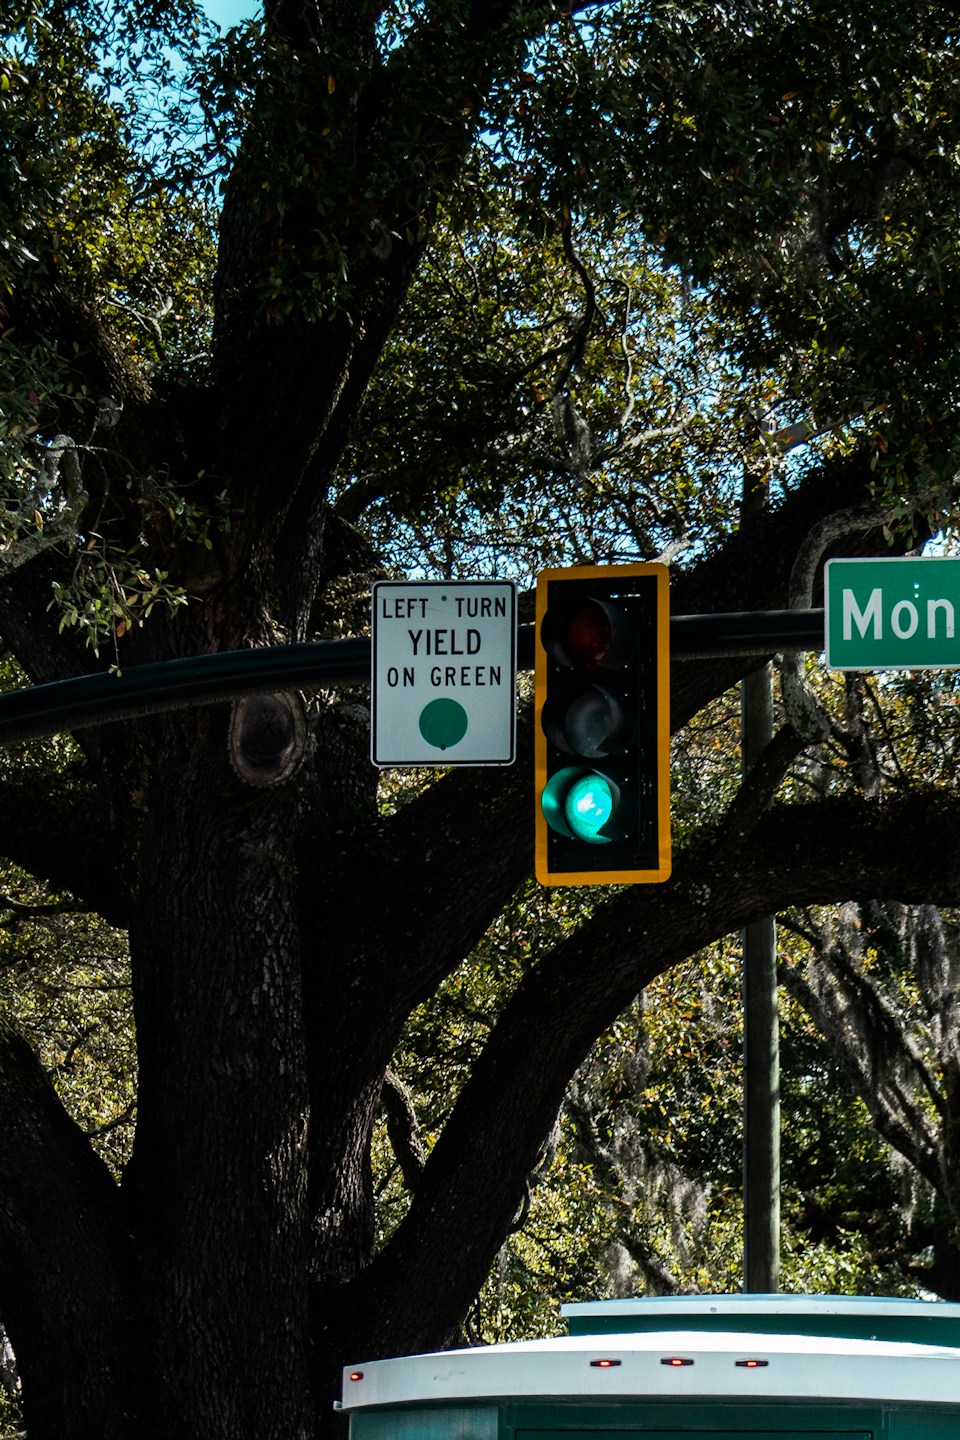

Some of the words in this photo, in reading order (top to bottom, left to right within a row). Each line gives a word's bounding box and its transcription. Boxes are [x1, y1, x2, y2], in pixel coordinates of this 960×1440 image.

[383, 598, 429, 618] LEFT
[455, 597, 506, 617] TURN
[408, 629, 482, 655] YIELD
[387, 667, 415, 687] ON
[430, 666, 501, 687] GREEN
